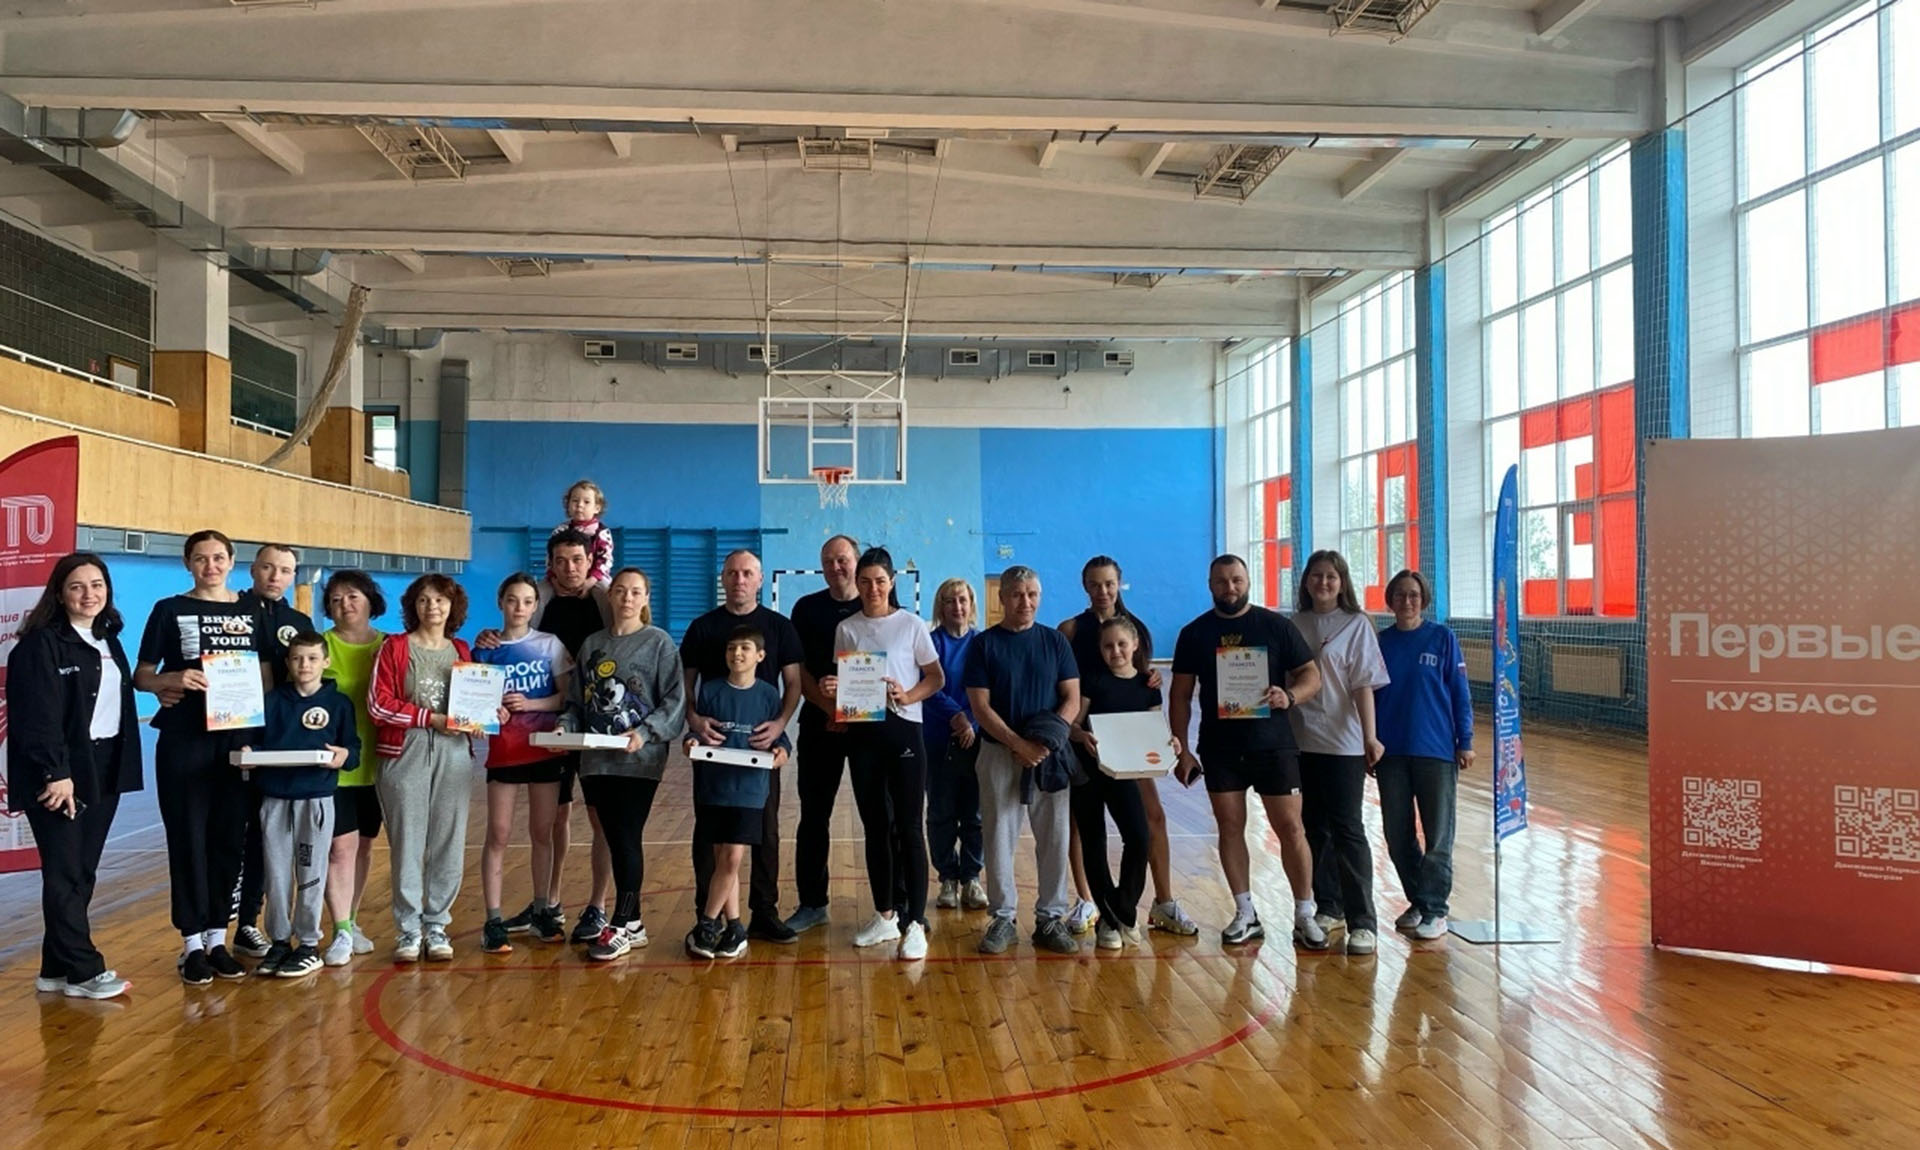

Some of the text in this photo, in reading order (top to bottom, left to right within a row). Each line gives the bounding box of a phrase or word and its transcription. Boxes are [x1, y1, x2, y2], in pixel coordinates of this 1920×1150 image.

[209, 636, 251, 646] YOUR
[1670, 612, 1920, 673] Первые
[504, 660, 545, 679] РОСС
[1706, 690, 1877, 716] КУЗБАСС
